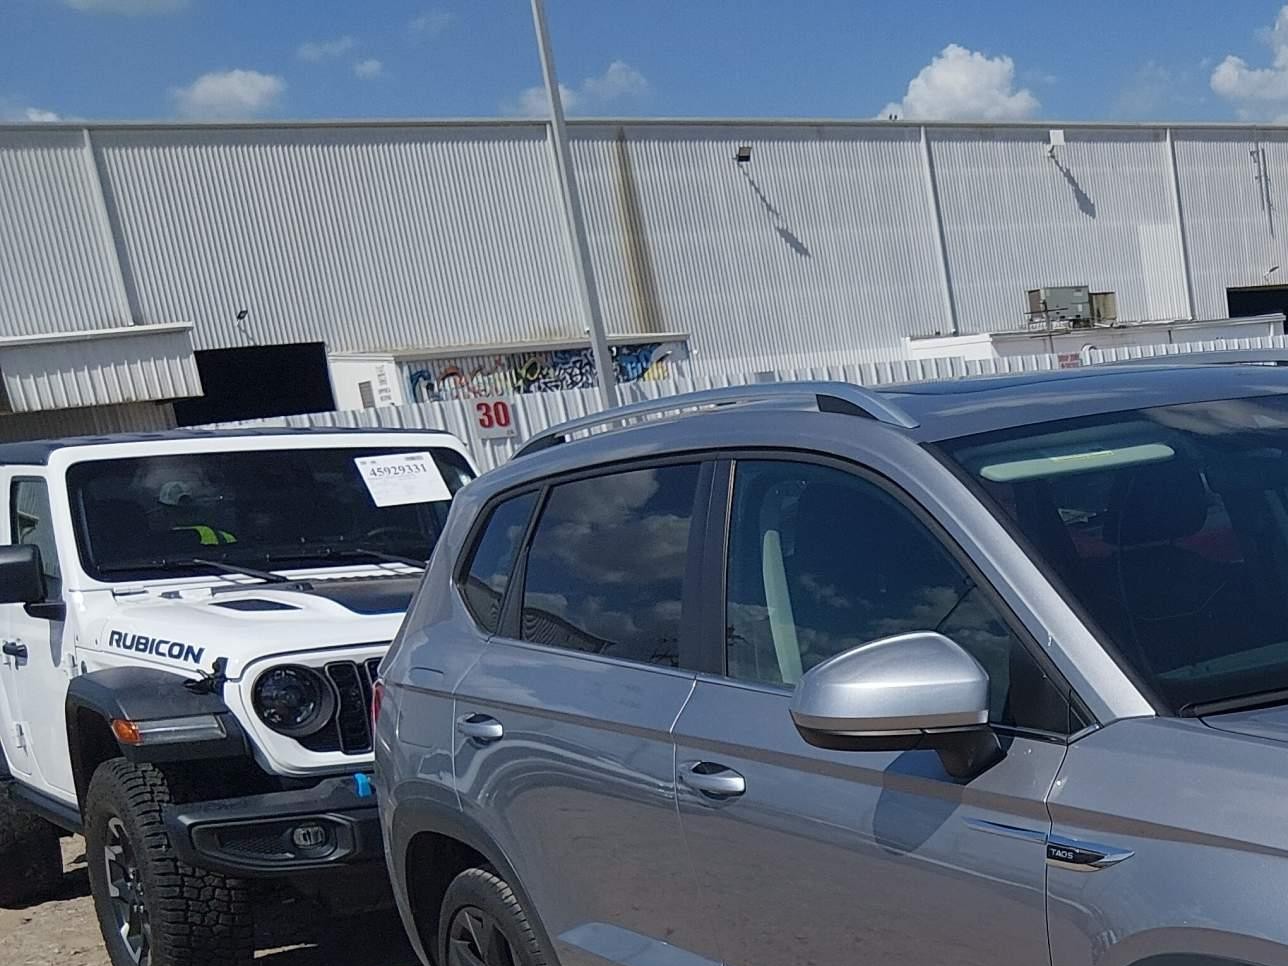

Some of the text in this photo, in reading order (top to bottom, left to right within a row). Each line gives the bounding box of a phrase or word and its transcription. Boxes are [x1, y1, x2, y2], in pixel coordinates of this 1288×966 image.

[475, 401, 511, 429] 30
[369, 463, 428, 477] 45929331
[108, 629, 206, 665] RUBICON
[1050, 847, 1074, 860] TAOS
